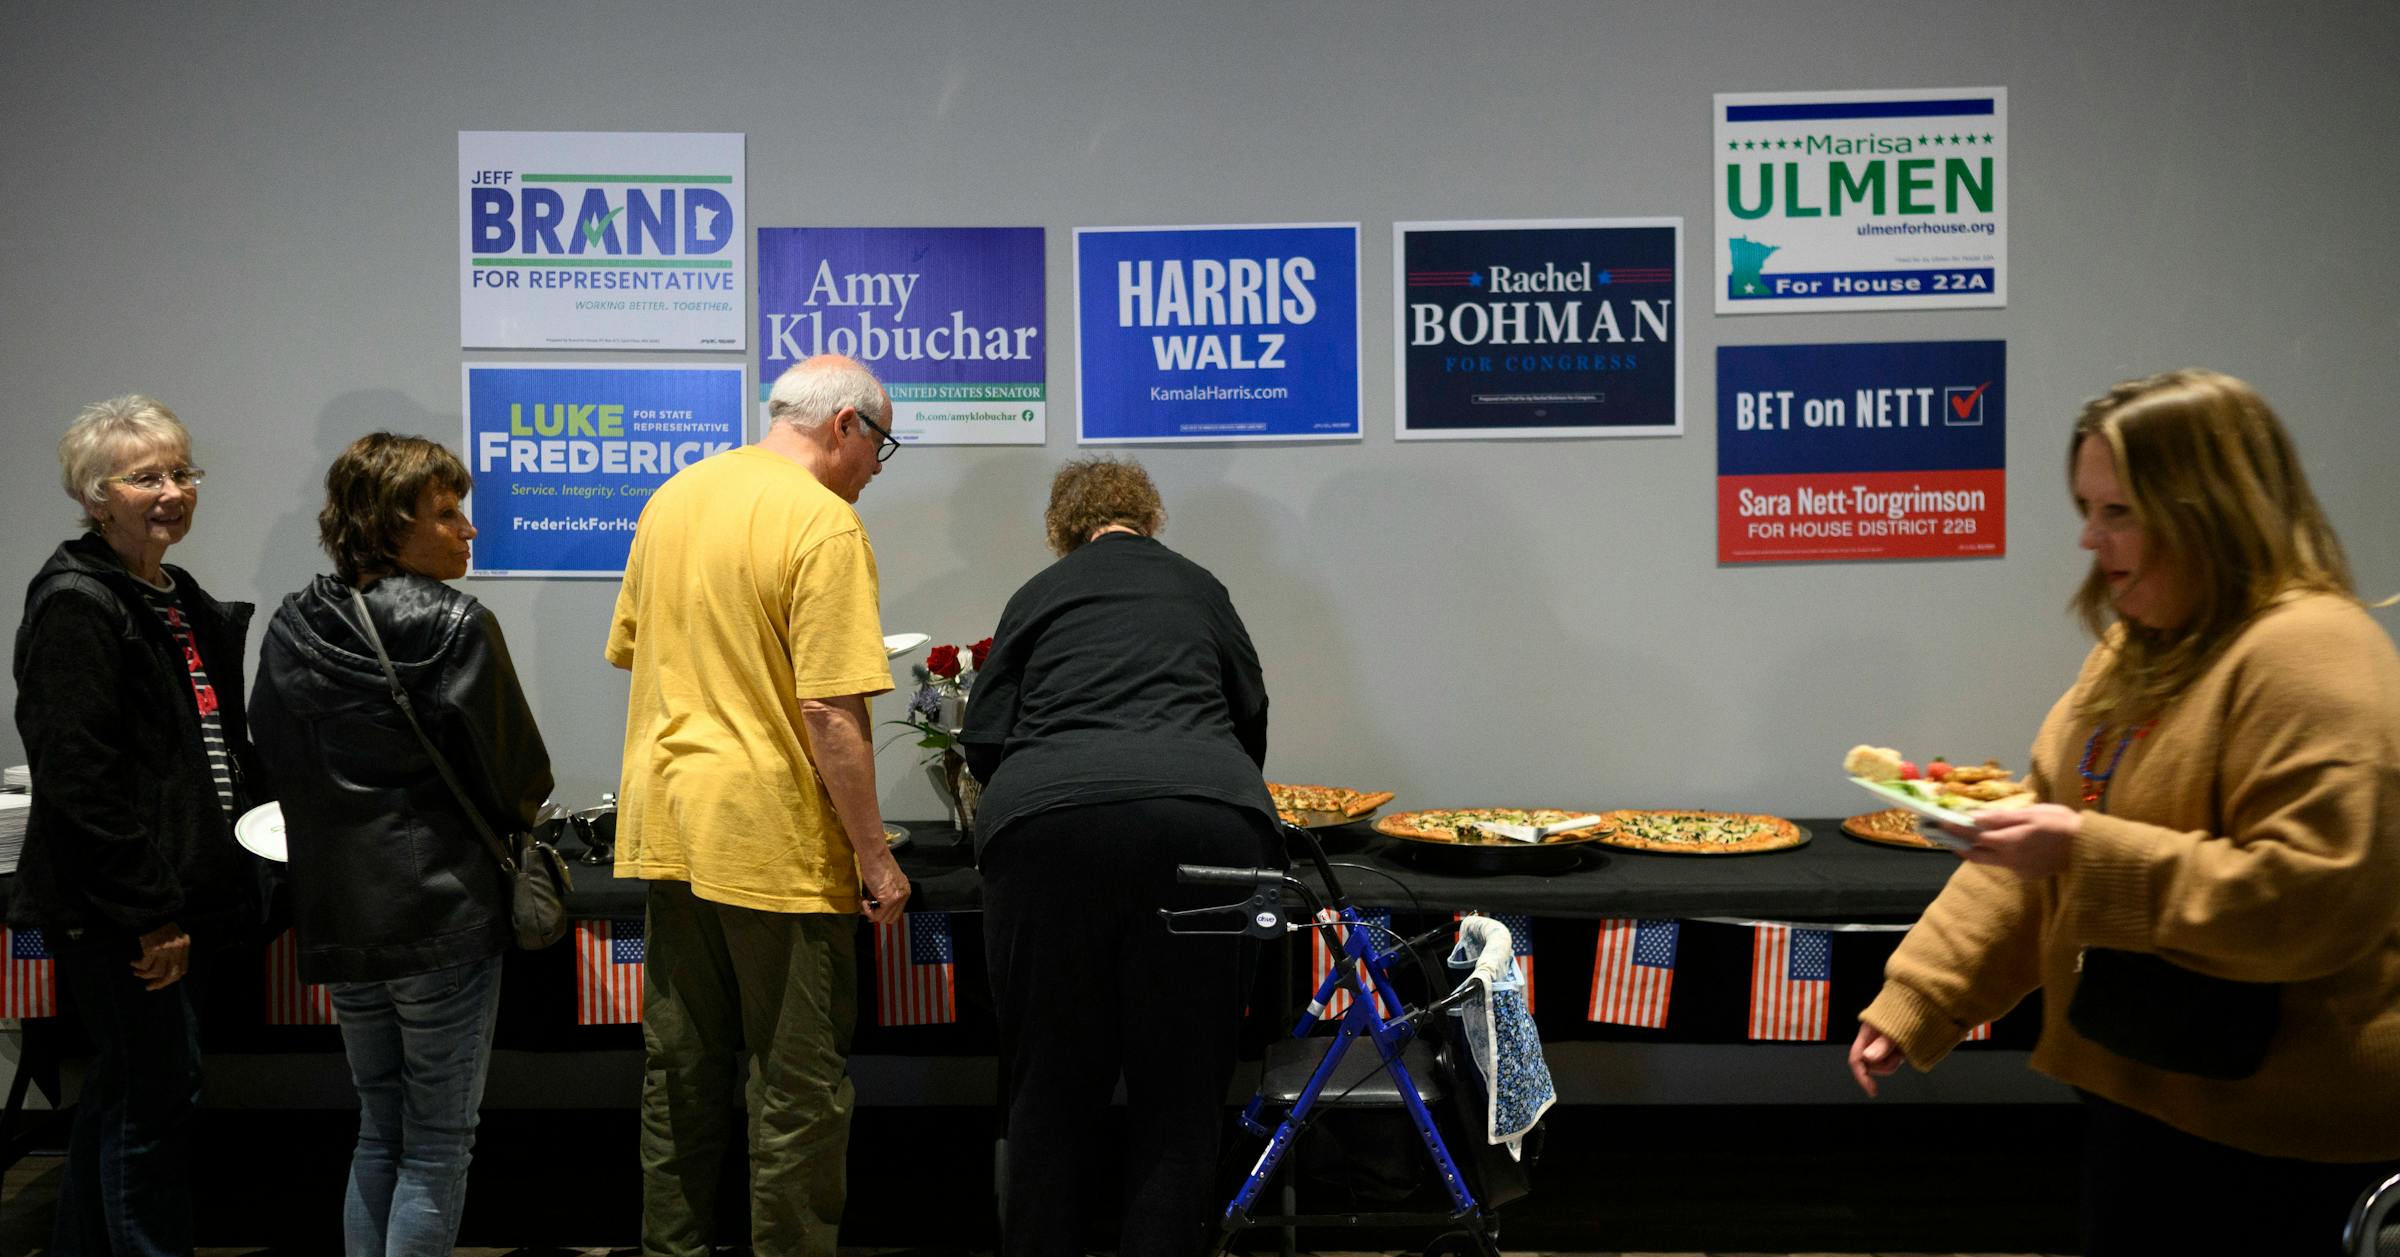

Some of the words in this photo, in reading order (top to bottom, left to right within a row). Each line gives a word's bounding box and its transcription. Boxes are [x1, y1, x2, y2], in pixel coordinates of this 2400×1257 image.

[1806, 133, 1912, 155] Marisa
[472, 171, 513, 184] JEFF
[1728, 157, 1994, 220] ULMEN
[472, 188, 733, 254] BRAND
[1857, 222, 1995, 236] ulmenforhouse.org
[473, 271, 519, 288] FOR
[529, 271, 733, 290] REPRESENTATIVE
[1488, 261, 1592, 293] Rachel
[1776, 278, 1822, 294] For
[1833, 276, 1921, 292] House
[1933, 274, 1987, 290] 22A
[803, 259, 920, 322] Amy
[1118, 256, 1316, 327] HARRIS
[576, 301, 625, 311] WORKING
[628, 302, 669, 312] BETTER.
[674, 302, 733, 312] TOGETHER.
[1410, 300, 1672, 346] BOHMAN
[767, 310, 1038, 360] Klobuchar
[1152, 334, 1286, 370] WALZ
[1445, 356, 1492, 372] FOR
[1505, 354, 1638, 371] CONGRESS
[890, 387, 936, 398] UNITED
[939, 387, 983, 398] STATES
[985, 387, 1040, 398] SENATOR
[1150, 385, 1288, 401] KamalaHarris.com
[634, 410, 656, 420] FOR
[659, 410, 692, 420] STATE
[916, 410, 1016, 422] fb.com/amyklobuchar
[1737, 391, 1794, 430] BET
[1804, 399, 1845, 427] on
[1856, 388, 1934, 428] NETT
[511, 403, 624, 437] LUKE
[634, 423, 729, 432] REPRESENTATIVE
[511, 483, 558, 496] Service.
[562, 484, 615, 500] Integrity.
[1739, 488, 1791, 516] Sara
[1798, 485, 1986, 519] Nett-Torgrimson
[1748, 523, 1784, 538] FOR
[1790, 522, 1852, 538] HOUSE
[1859, 520, 1938, 536] DISTRICT
[1943, 518, 1976, 534] 22B
